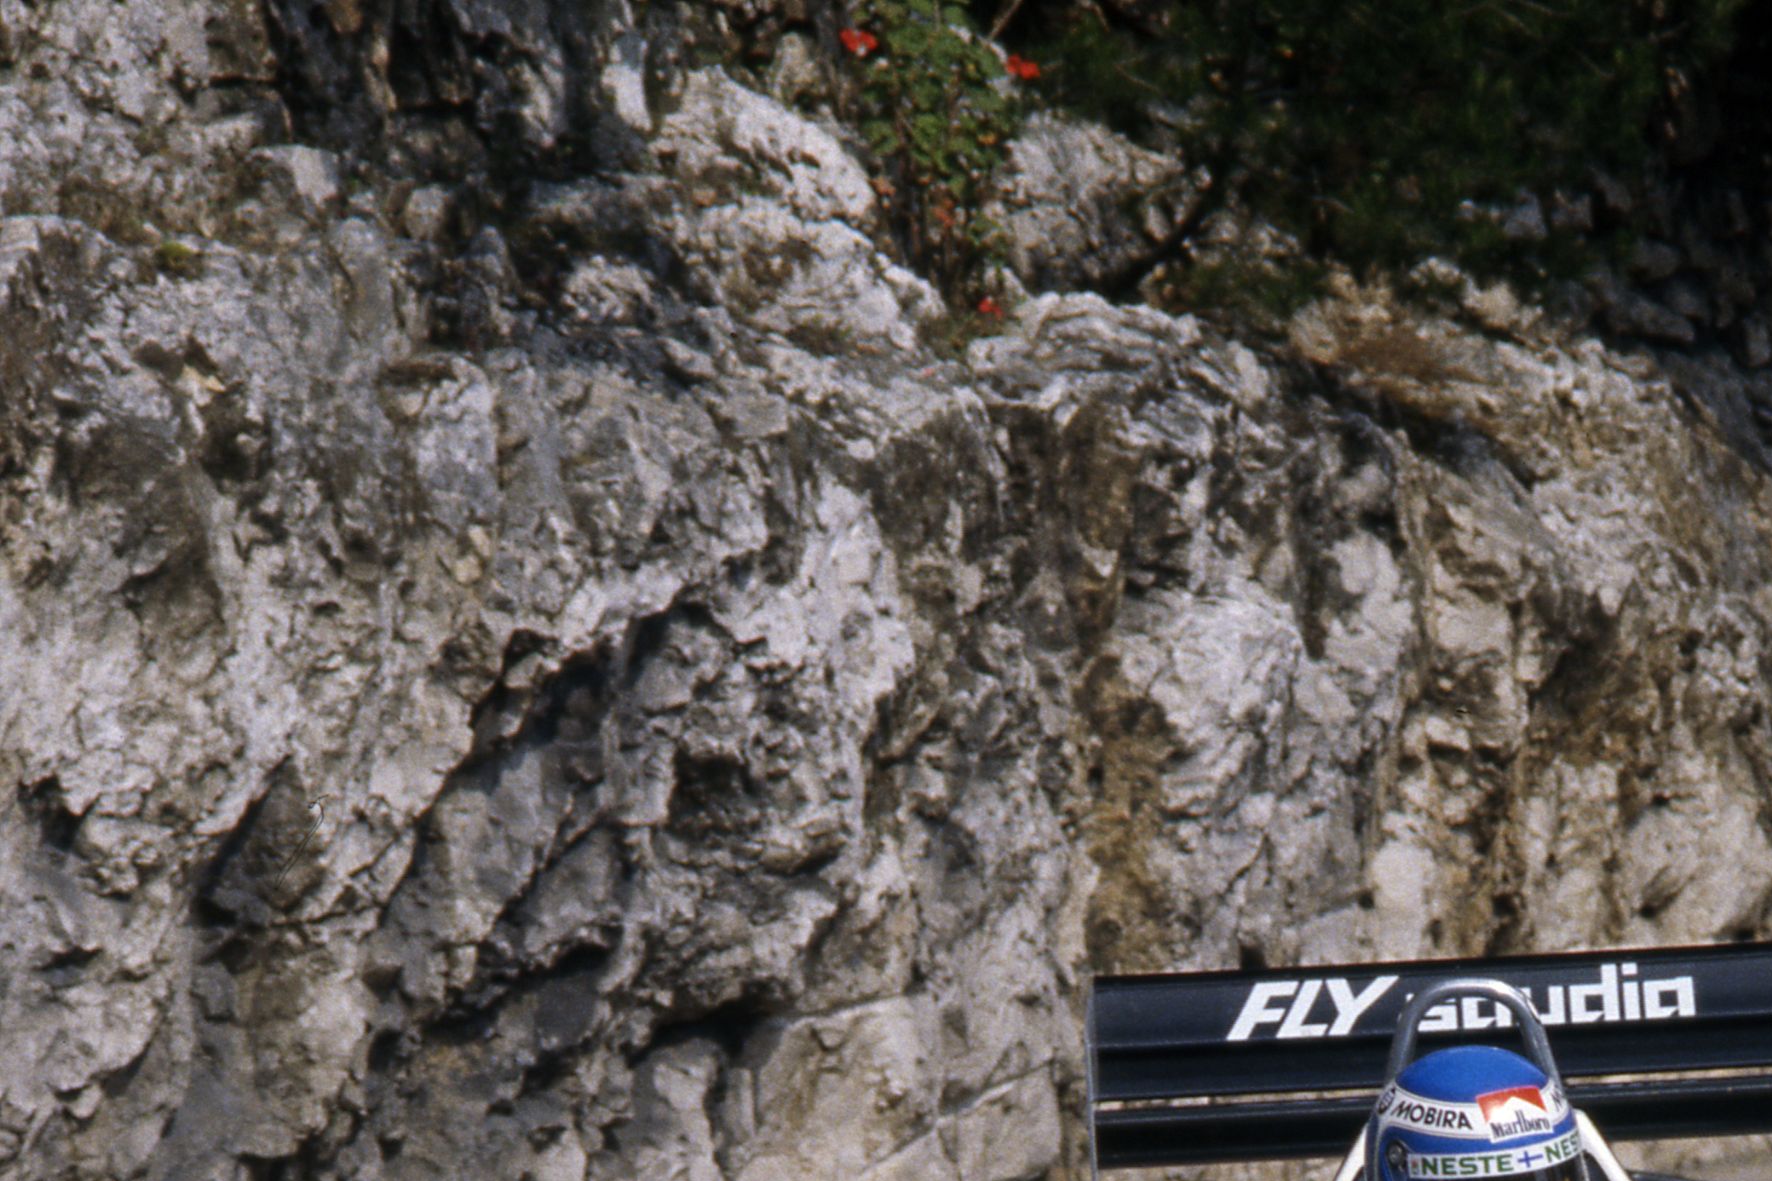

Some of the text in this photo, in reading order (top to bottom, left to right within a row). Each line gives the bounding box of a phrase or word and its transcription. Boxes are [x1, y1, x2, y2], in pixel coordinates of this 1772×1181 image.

[1226, 975, 1399, 1041] FLY
[1392, 1100, 1473, 1131] MOBIRA
[1490, 1109, 1551, 1139] Marlboro
[1421, 1153, 1514, 1176] NESTE
